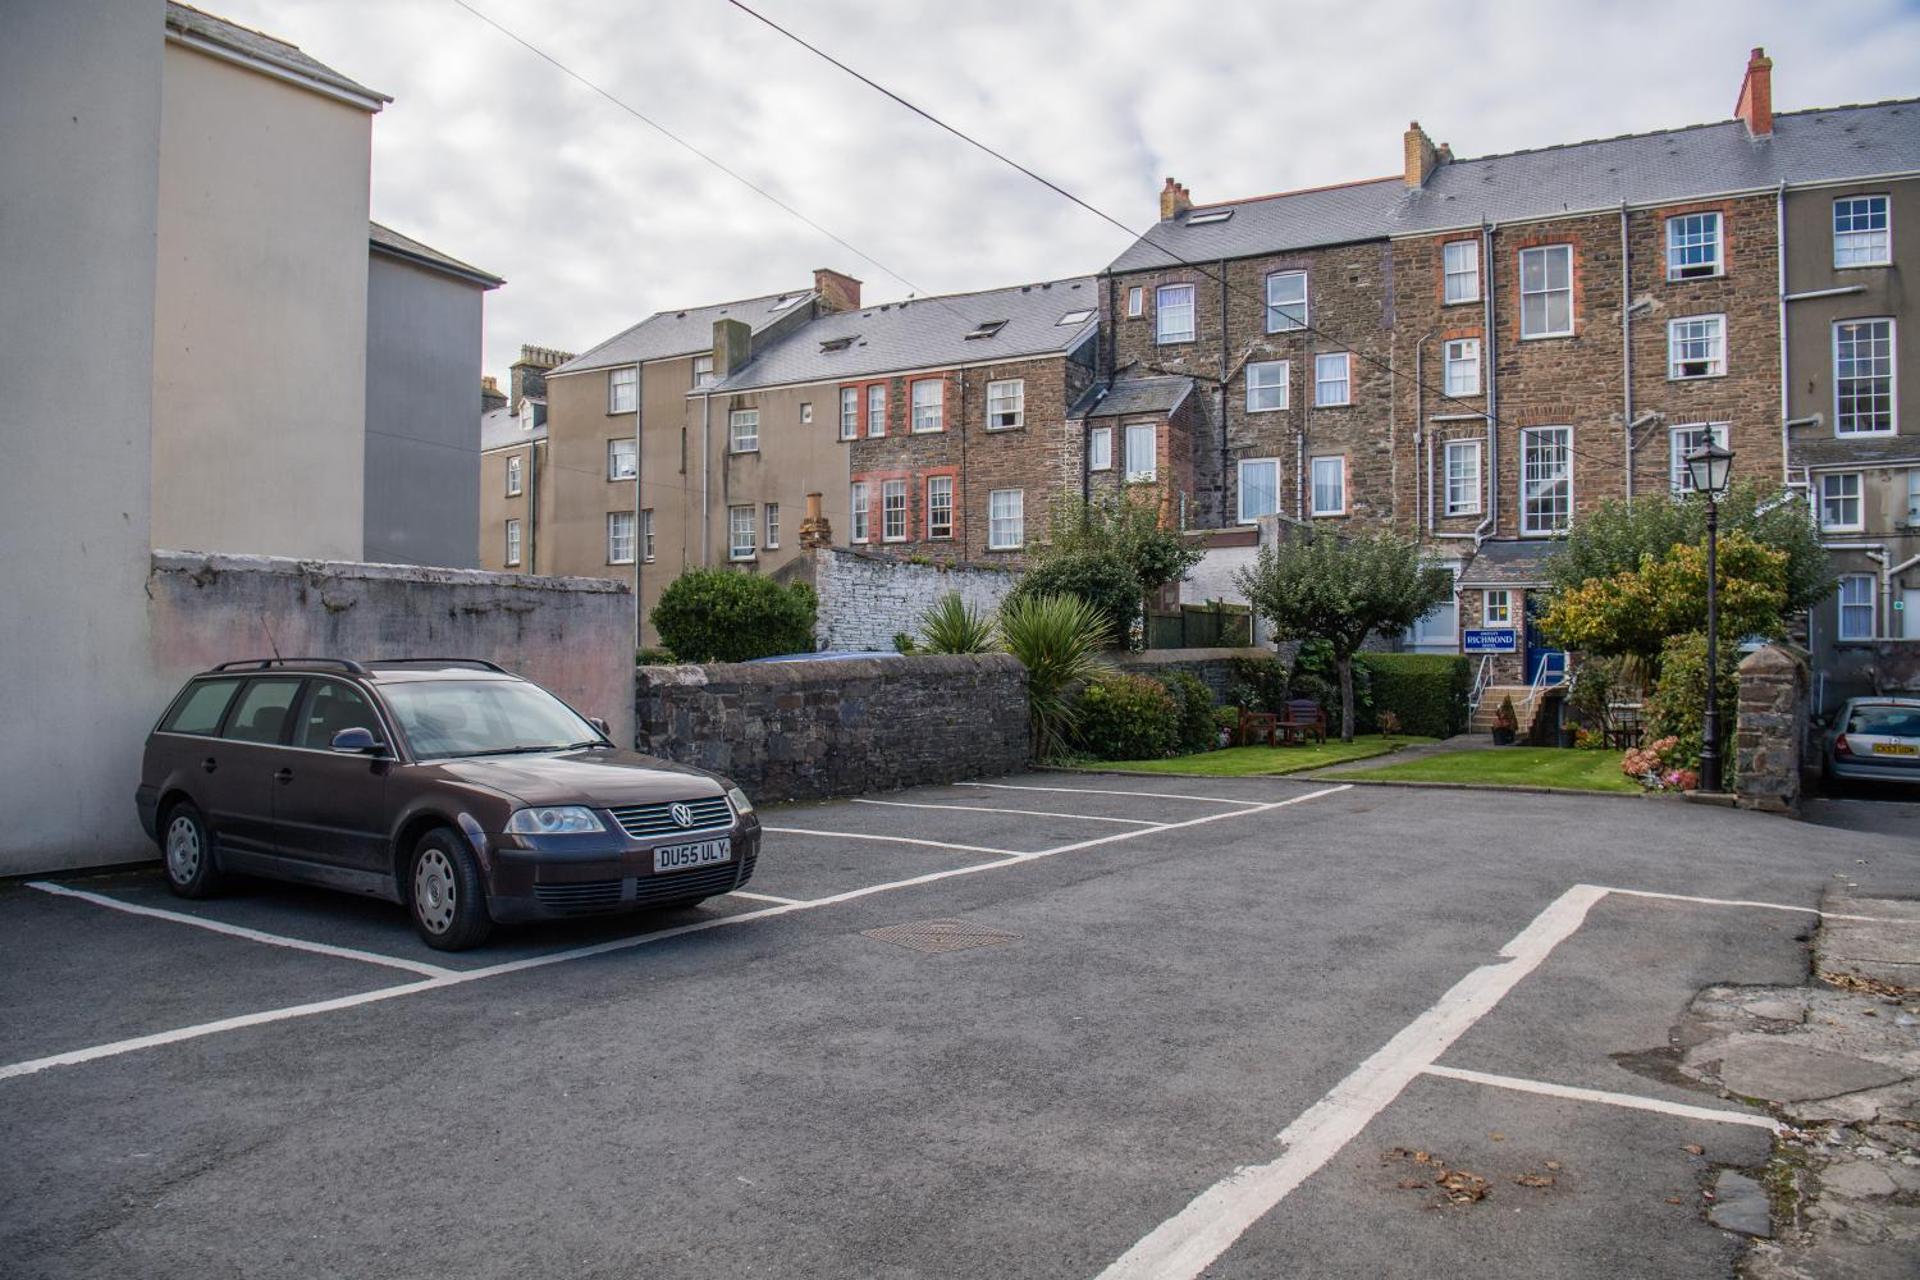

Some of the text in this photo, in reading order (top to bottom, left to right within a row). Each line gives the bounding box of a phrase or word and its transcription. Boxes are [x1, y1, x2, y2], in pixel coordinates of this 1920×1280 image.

[1467, 635, 1513, 644] RICHMOND
[661, 841, 726, 868] DU55 ULY
